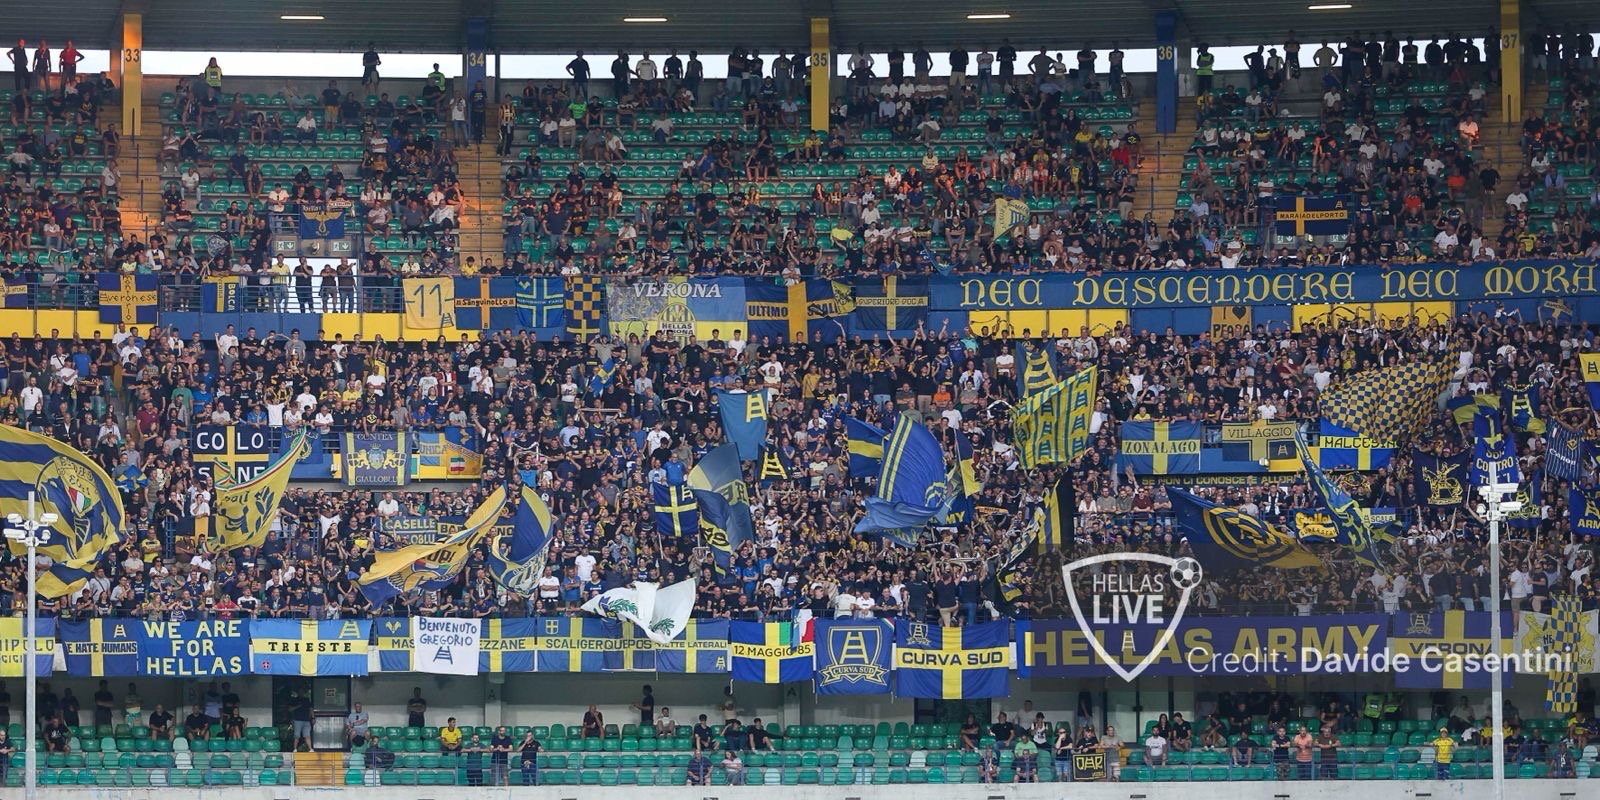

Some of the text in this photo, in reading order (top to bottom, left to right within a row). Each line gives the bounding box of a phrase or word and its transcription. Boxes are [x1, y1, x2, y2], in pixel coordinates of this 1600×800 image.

[1503, 34, 1517, 48] 37
[126, 48, 140, 62] 33
[470, 52, 484, 66] 34
[813, 52, 828, 66] 35
[1159, 46, 1172, 60] 36
[632, 281, 722, 298] VERONA
[749, 306, 788, 318] ULTIMO
[1228, 427, 1292, 438] VILLAGGIO
[385, 519, 436, 529] CASELLE
[142, 620, 242, 638] WE ARE
[419, 618, 478, 634] BENVENUTO
[268, 642, 352, 652] TRIESTE
[420, 634, 473, 646] GREGORIO
[1024, 624, 1380, 667] HELLAS ARMY
[76, 643, 98, 653] HATE
[102, 642, 137, 652] HUMANS
[172, 640, 215, 657] FOR
[734, 646, 744, 655] 12
[146, 656, 242, 675] HELLAS
[902, 652, 1002, 666] CURVA SUD
[833, 666, 874, 674] CURVA SUD
